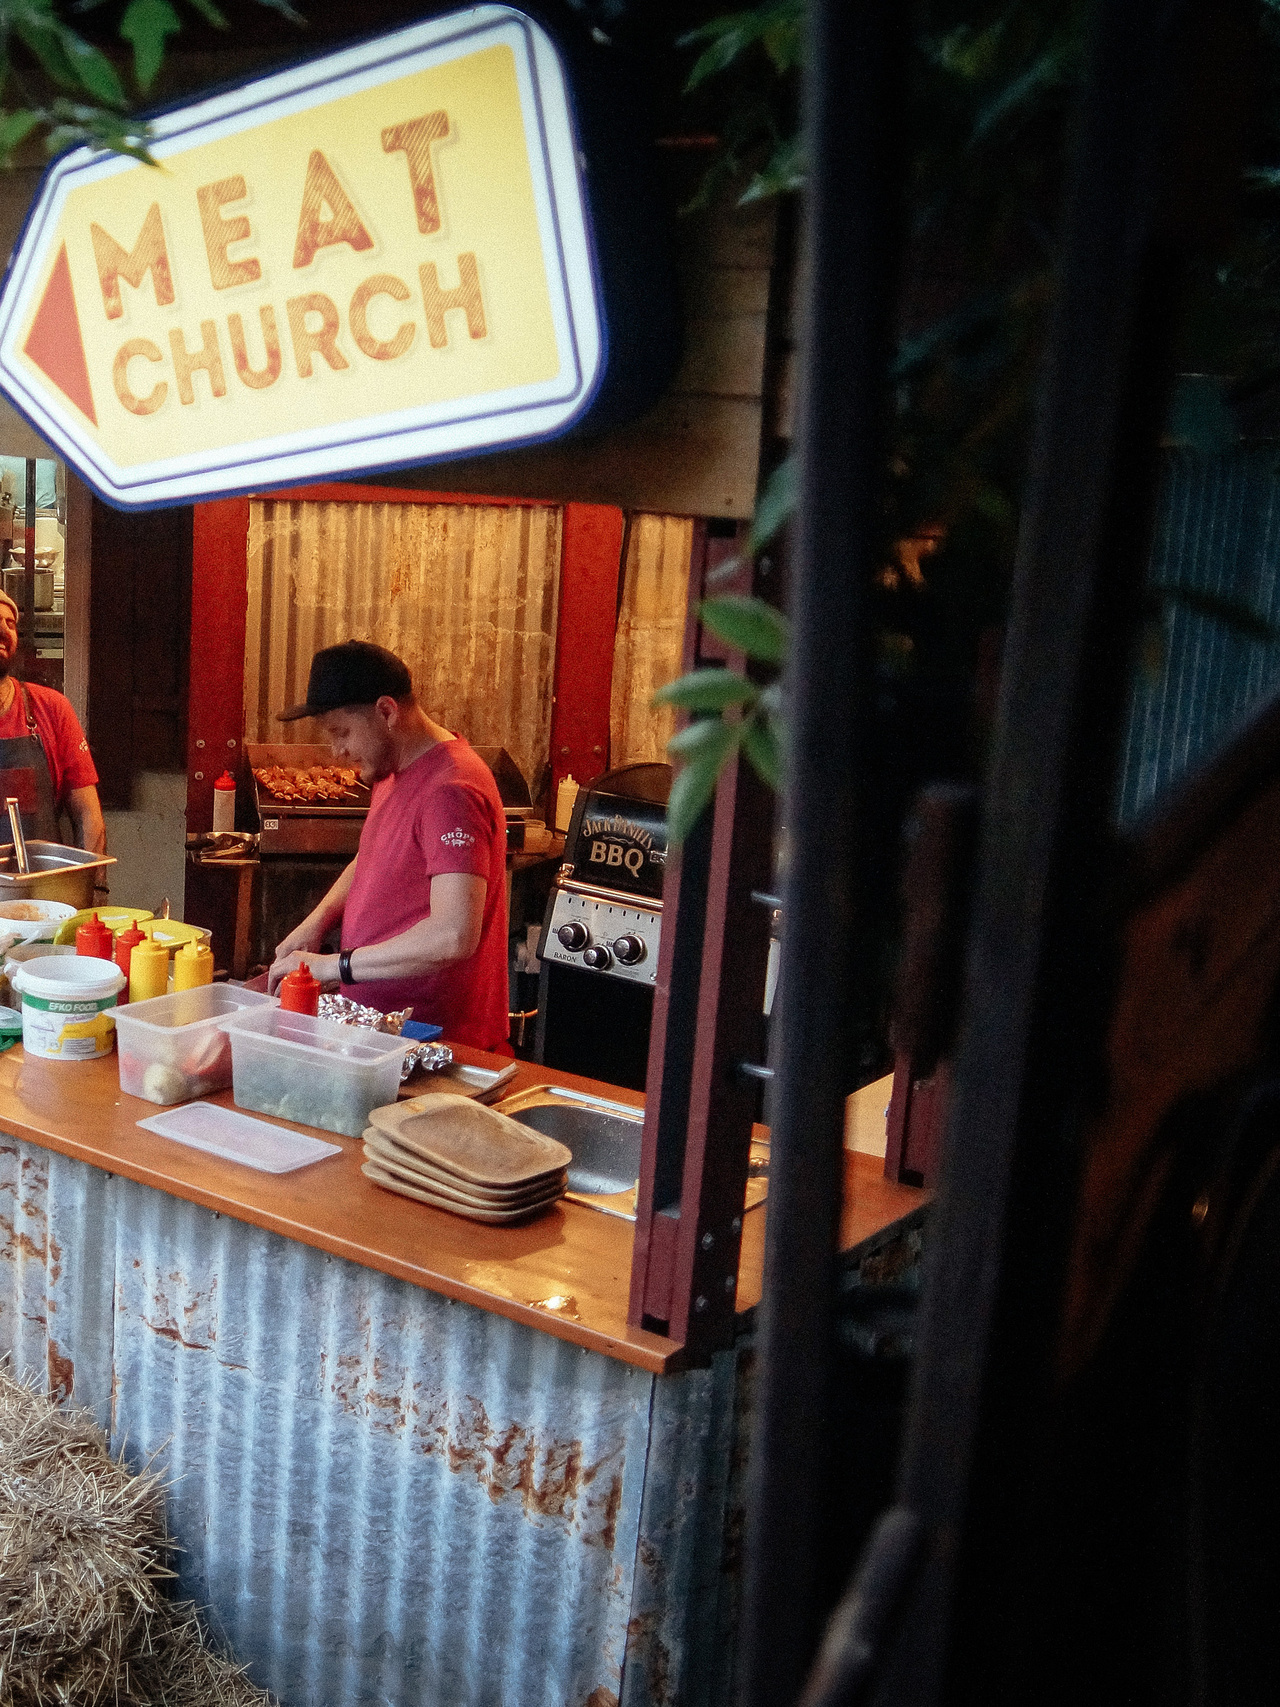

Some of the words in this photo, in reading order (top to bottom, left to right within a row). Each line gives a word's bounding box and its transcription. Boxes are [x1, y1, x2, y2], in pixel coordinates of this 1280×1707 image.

[90, 109, 450, 321] MEAT
[112, 251, 488, 416] CHURCH
[589, 841, 644, 878] BBQ
[553, 951, 577, 963] BARON
[48, 1002, 72, 1012] EFKO
